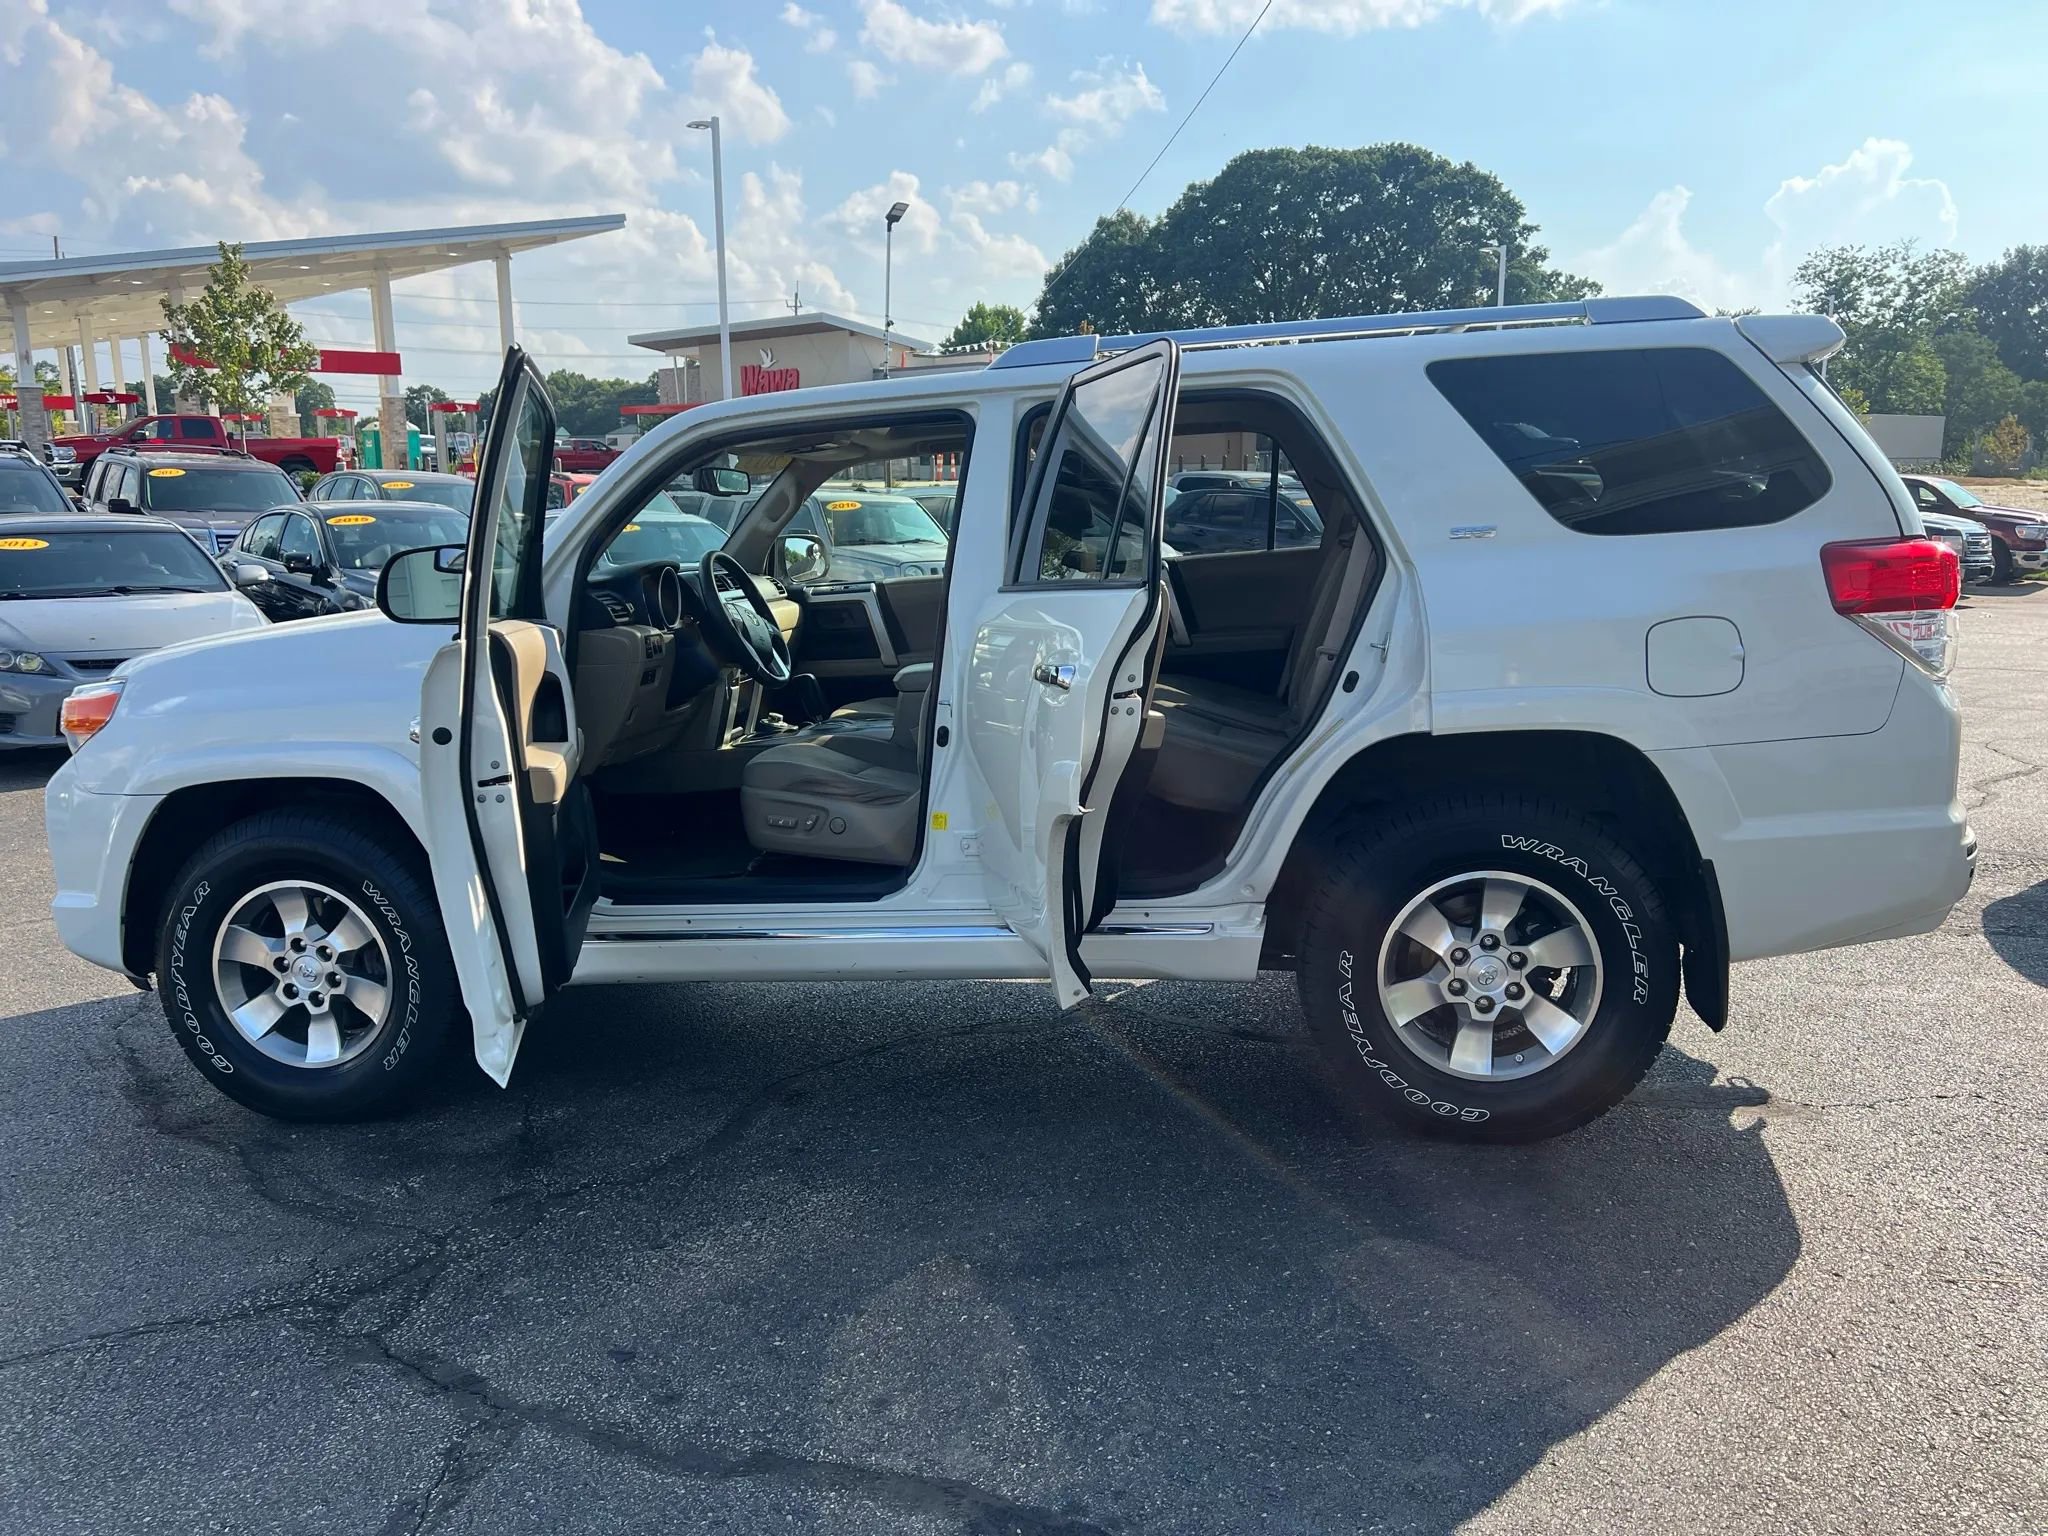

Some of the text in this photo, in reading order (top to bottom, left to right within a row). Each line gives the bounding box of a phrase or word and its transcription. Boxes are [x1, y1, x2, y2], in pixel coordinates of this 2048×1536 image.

[740, 364, 800, 397] Wawa
[831, 502, 857, 510] 2016
[168, 880, 234, 1074] GOODYEAR
[361, 880, 421, 1071] WRANGLER
[1502, 834, 1651, 1005] WRANGLER
[1338, 950, 1490, 1123] GOODYEAR
